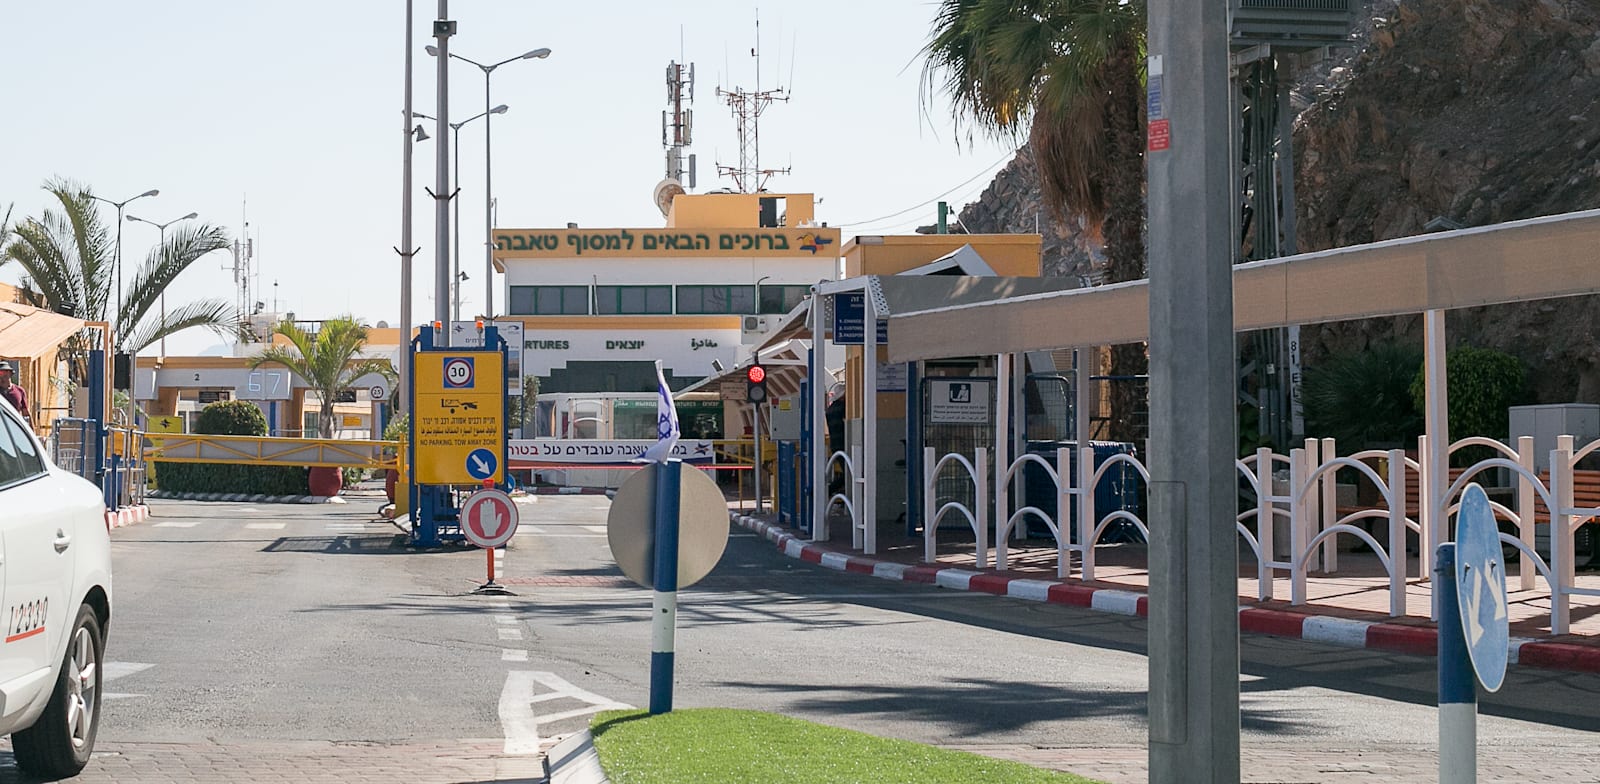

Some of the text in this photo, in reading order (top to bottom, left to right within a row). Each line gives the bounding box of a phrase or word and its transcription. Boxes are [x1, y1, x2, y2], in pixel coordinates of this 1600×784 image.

[496, 229, 790, 255] ברוכים הבאים למסוף טאבה
[524, 340, 570, 350] RTURES
[605, 339, 645, 350] יוצאים
[194, 373, 200, 381] 2
[450, 367, 466, 377] 30
[543, 443, 562, 456] על
[566, 445, 614, 456] עובדים
[617, 445, 649, 455] טאבה
